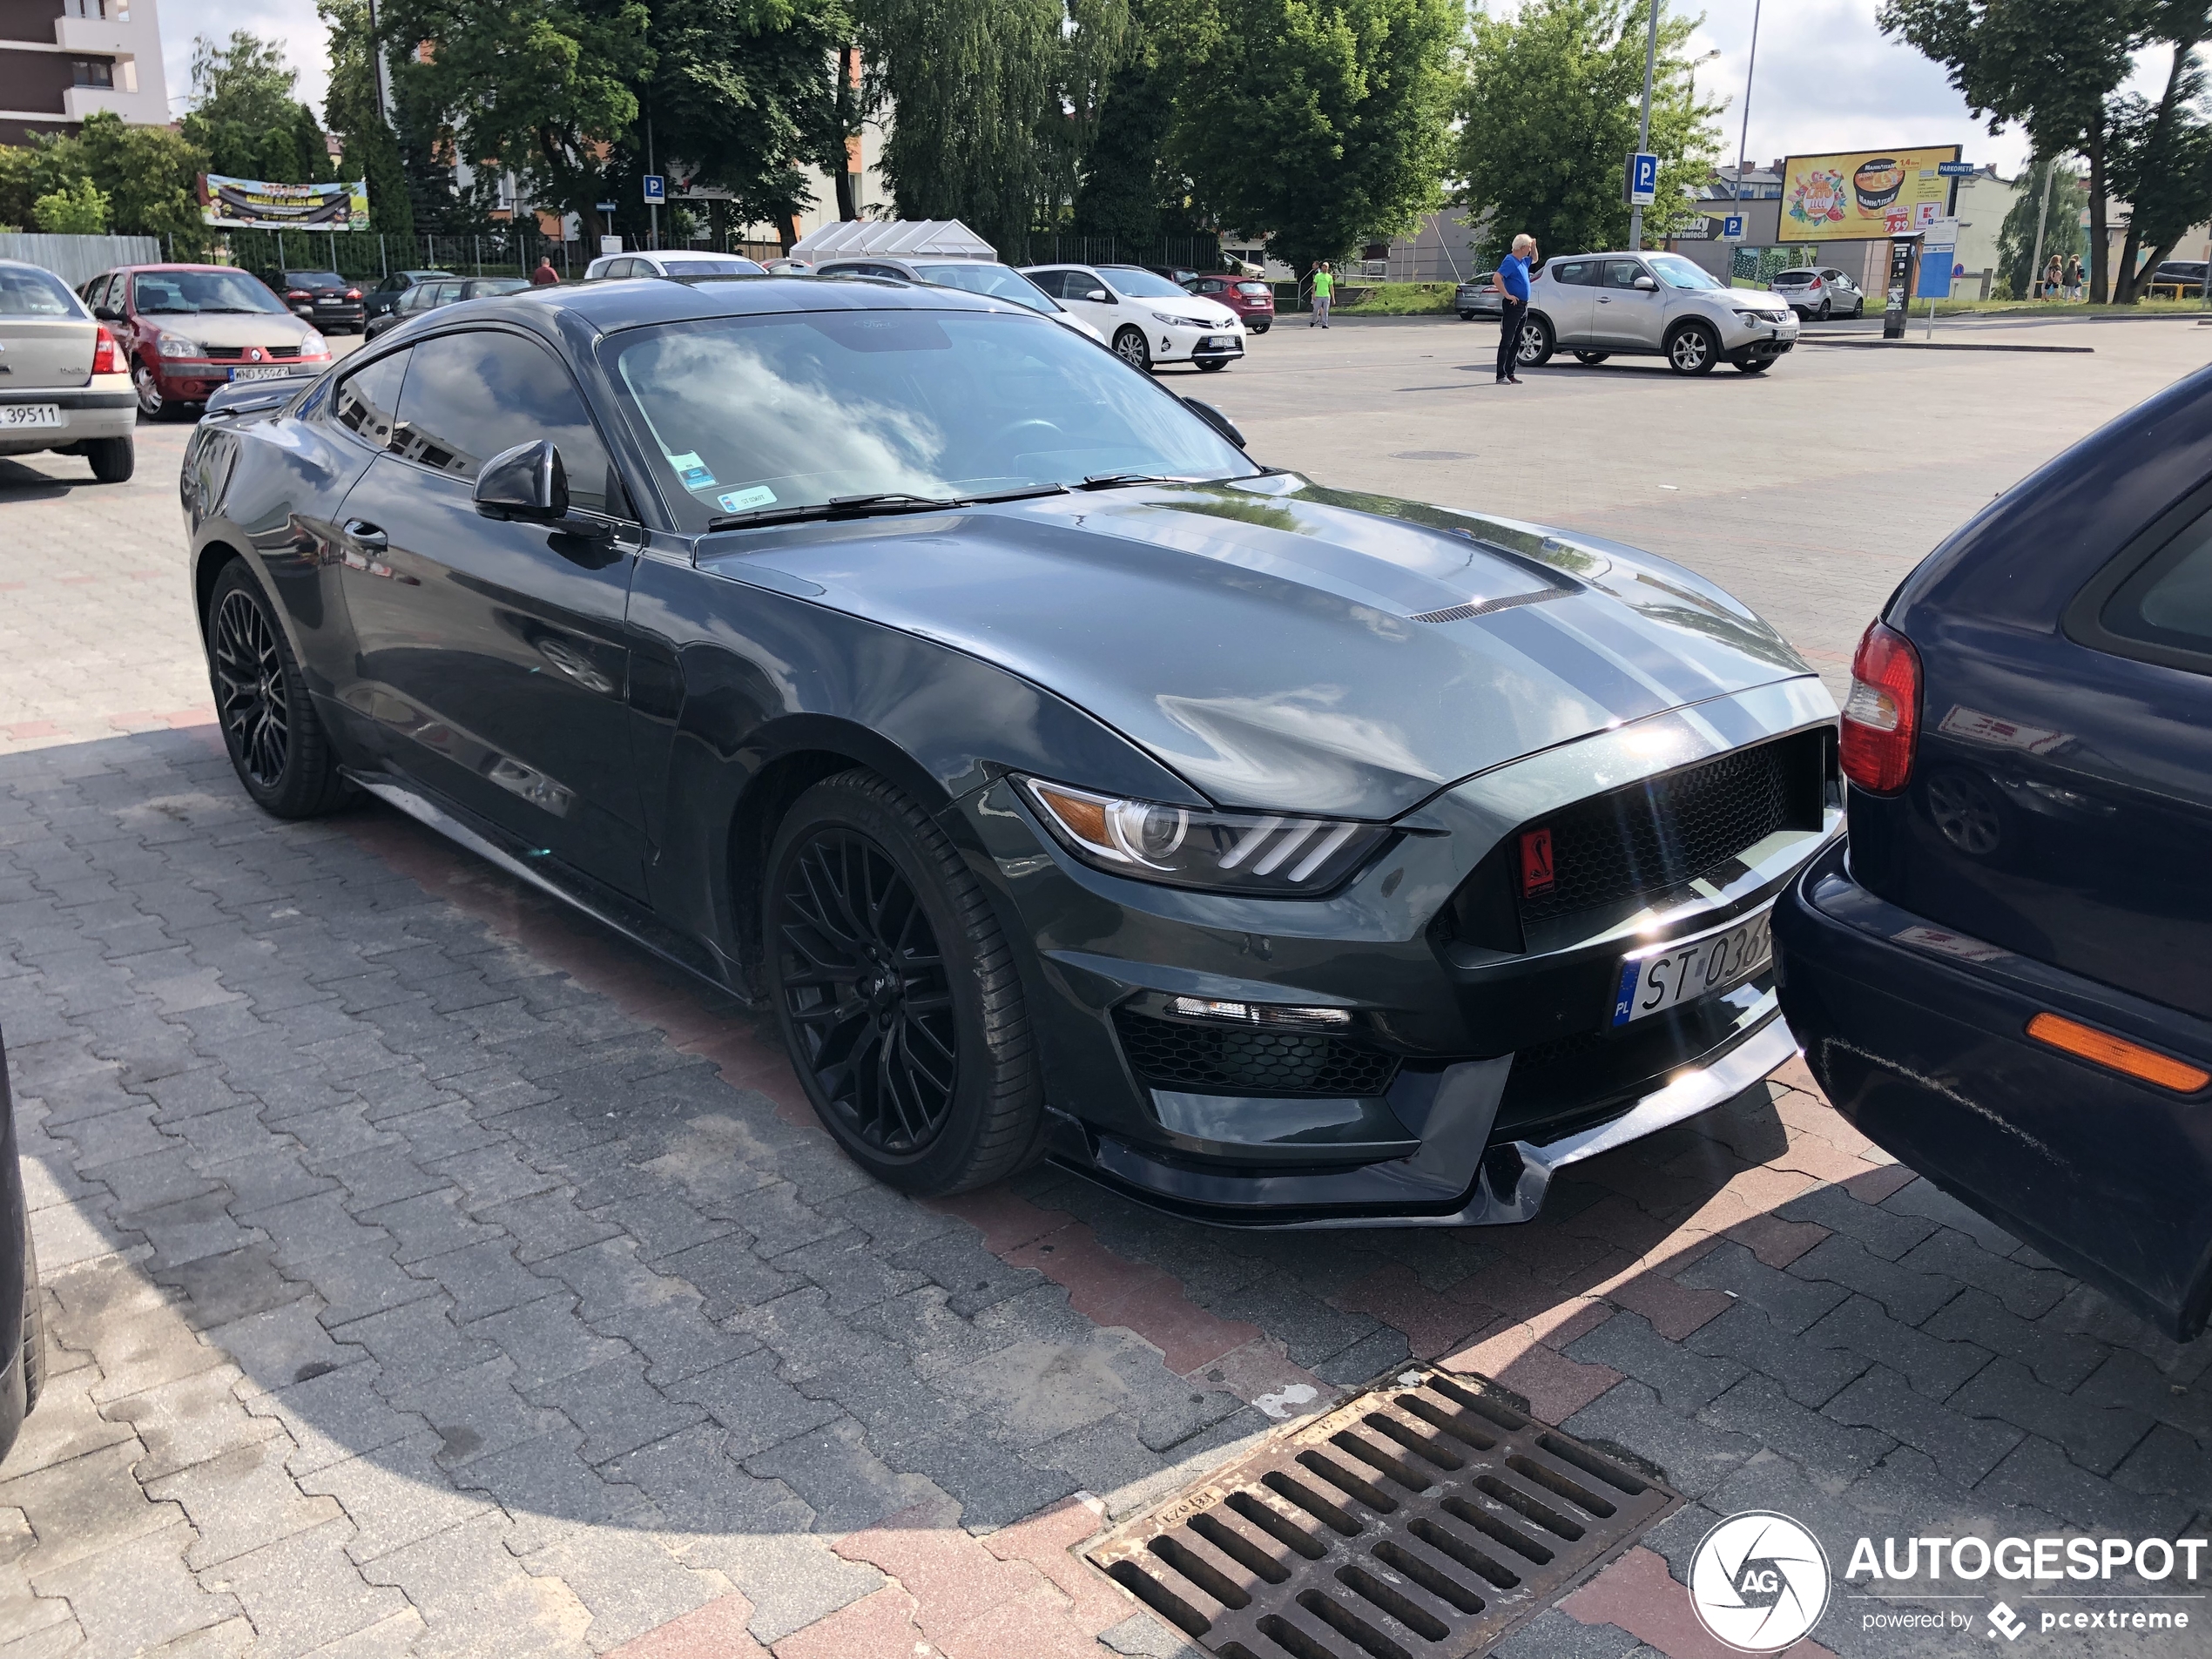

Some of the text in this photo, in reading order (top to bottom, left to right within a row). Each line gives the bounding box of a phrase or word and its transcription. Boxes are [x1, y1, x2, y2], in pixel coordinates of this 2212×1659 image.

[1641, 162, 1650, 185] P
[650, 180, 659, 193] P
[1859, 192, 1898, 206] MANHATTAN
[1729, 219, 1738, 233] P
[1884, 220, 1909, 233] 7,99
[7, 407, 56, 423] 39511
[1642, 947, 1698, 1009] ST
[1615, 1002, 1629, 1016] PL
